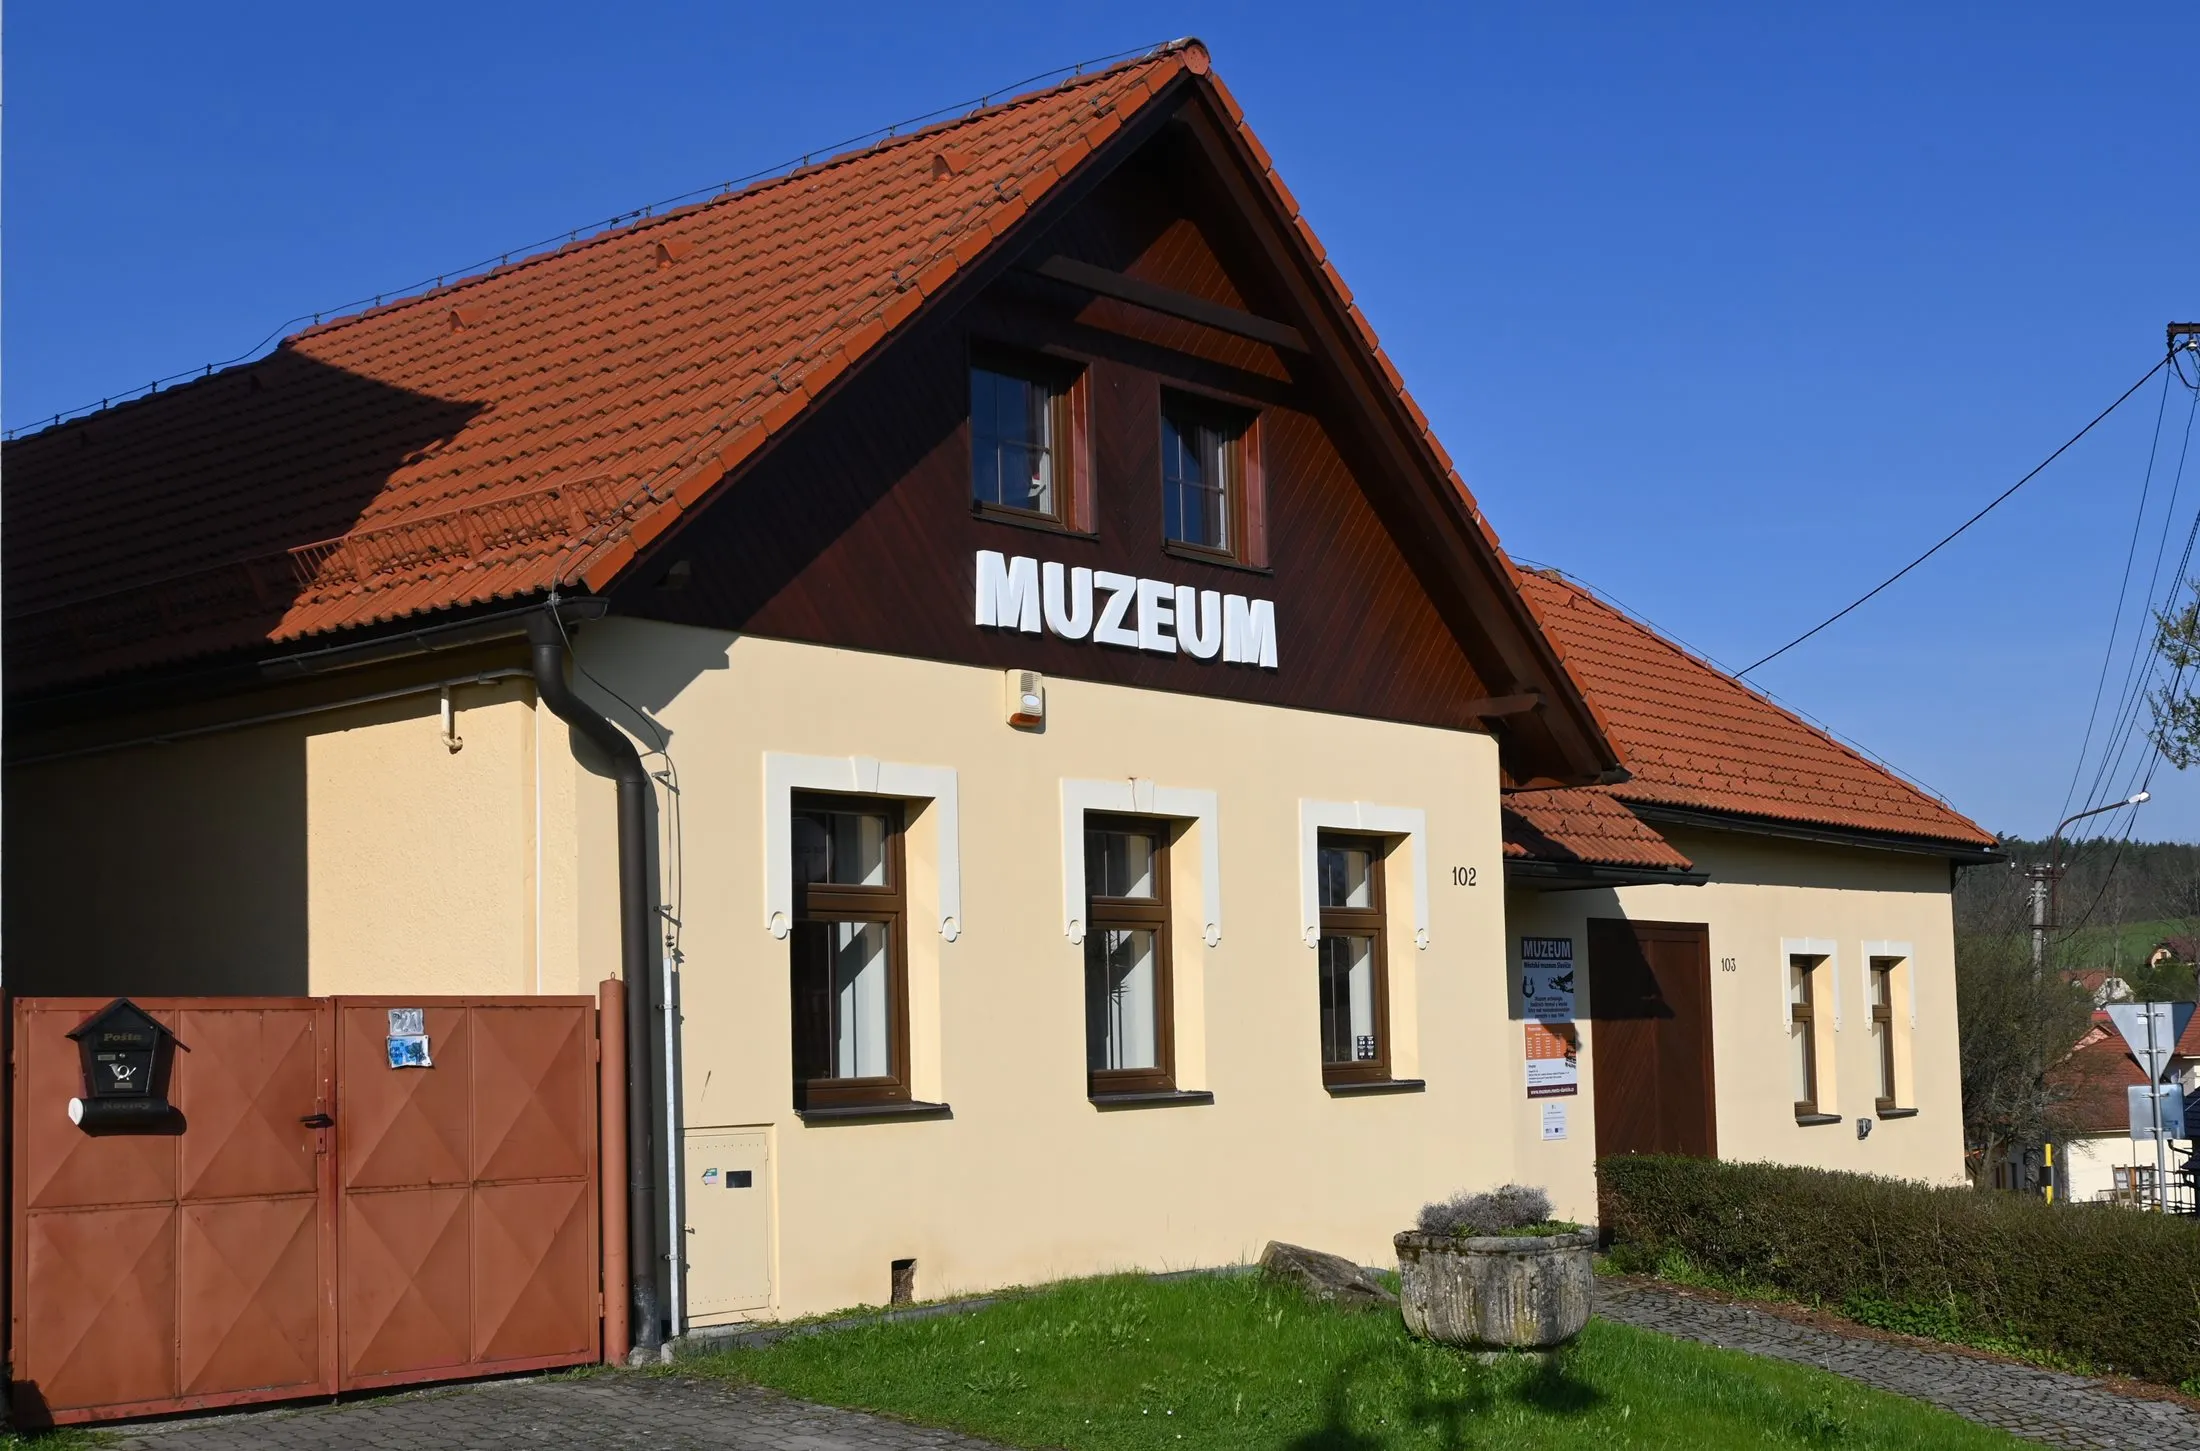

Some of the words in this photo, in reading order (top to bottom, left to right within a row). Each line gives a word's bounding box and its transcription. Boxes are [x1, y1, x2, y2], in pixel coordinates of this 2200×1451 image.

[974, 549, 1278, 669] MUZEUM
[1451, 866, 1477, 887] 102
[1523, 940, 1571, 957] MUZEUM
[1720, 957, 1736, 972] 103
